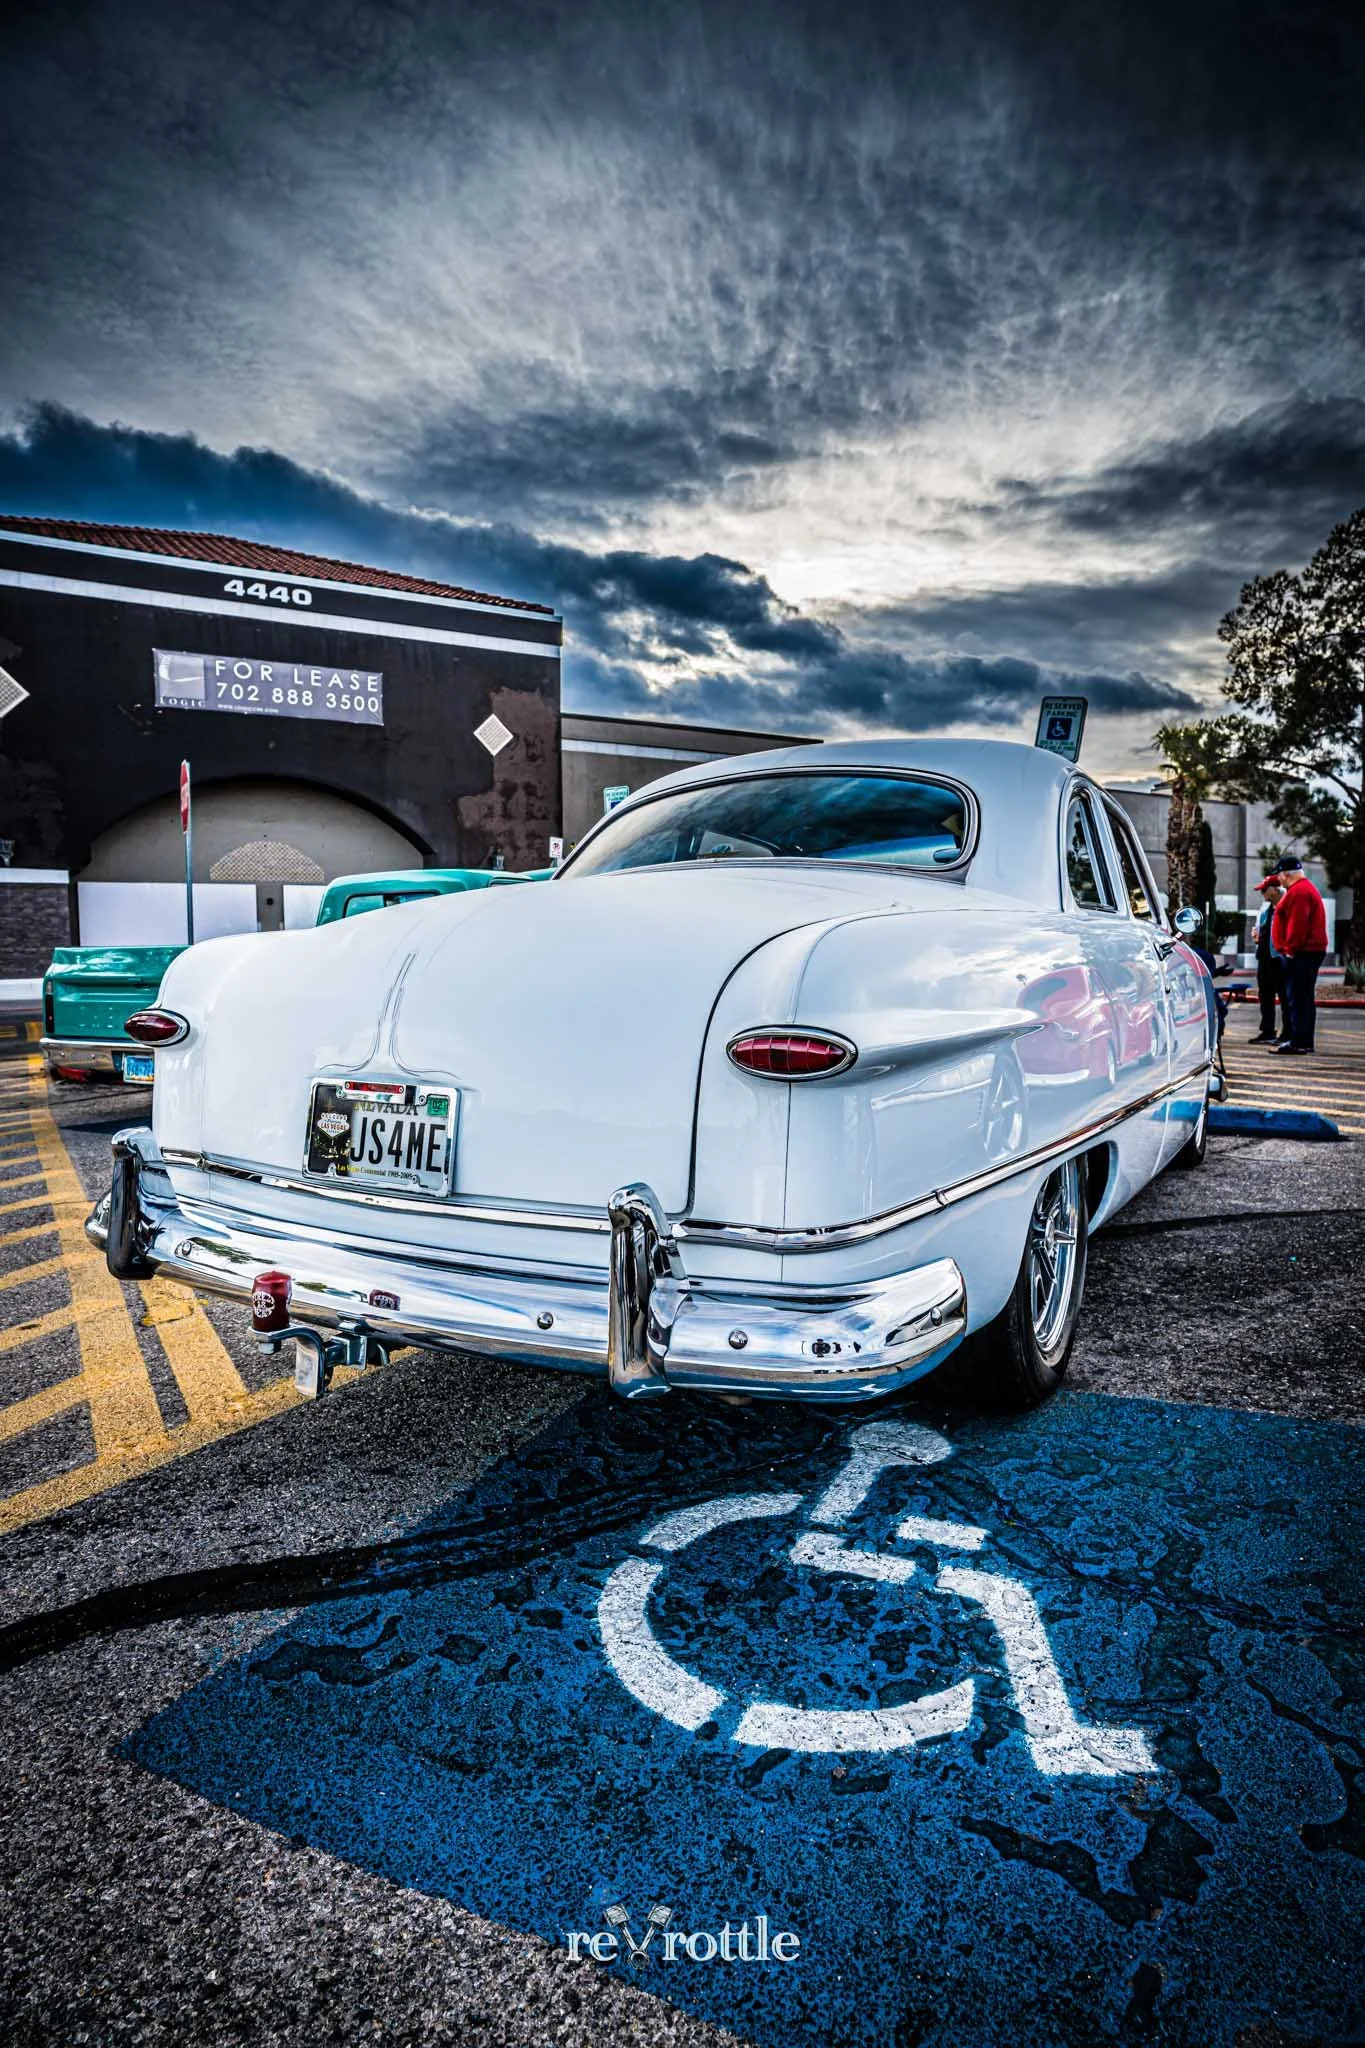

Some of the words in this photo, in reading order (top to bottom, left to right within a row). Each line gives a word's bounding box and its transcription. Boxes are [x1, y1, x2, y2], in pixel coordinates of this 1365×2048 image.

[223, 579, 313, 606] 4440
[215, 660, 273, 682] FOR
[293, 668, 379, 692] LEASE
[159, 696, 206, 708] LOGIC
[216, 682, 260, 701] 702
[271, 687, 314, 707] 888
[326, 693, 379, 713] 3500
[351, 1117, 446, 1173] JS4ME
